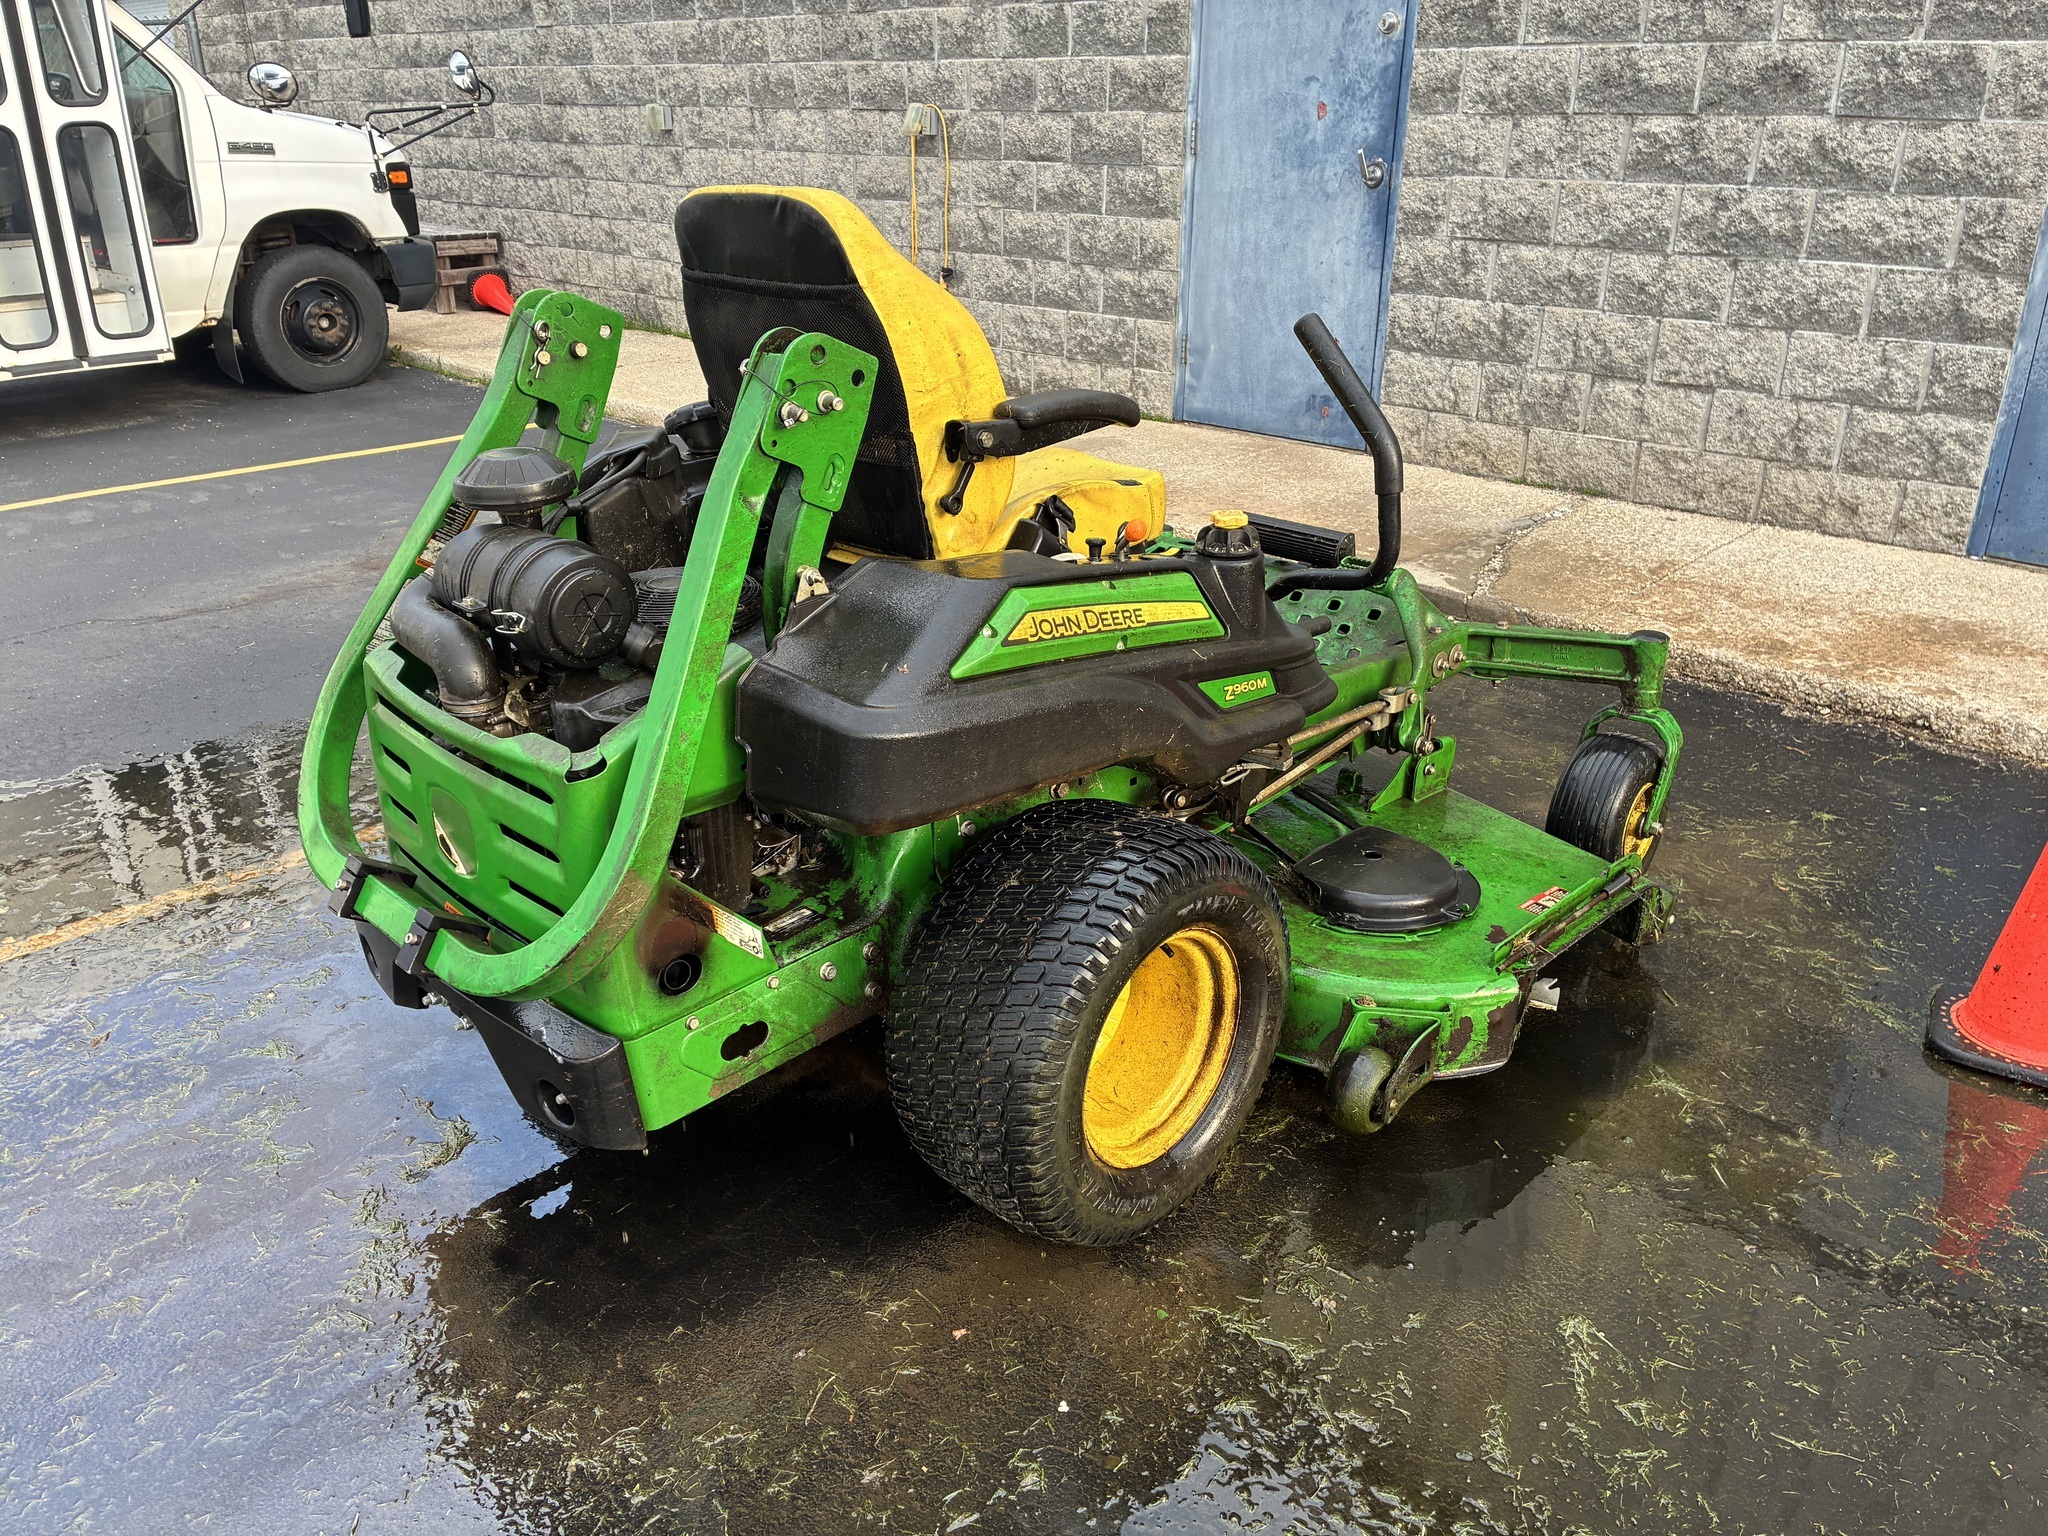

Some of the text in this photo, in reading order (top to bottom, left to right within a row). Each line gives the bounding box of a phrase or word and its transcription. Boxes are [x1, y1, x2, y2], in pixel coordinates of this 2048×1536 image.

[1029, 608, 1145, 638] JOHN DEERE
[1223, 677, 1268, 701] Z960M
[1177, 895, 1246, 920] TURF
